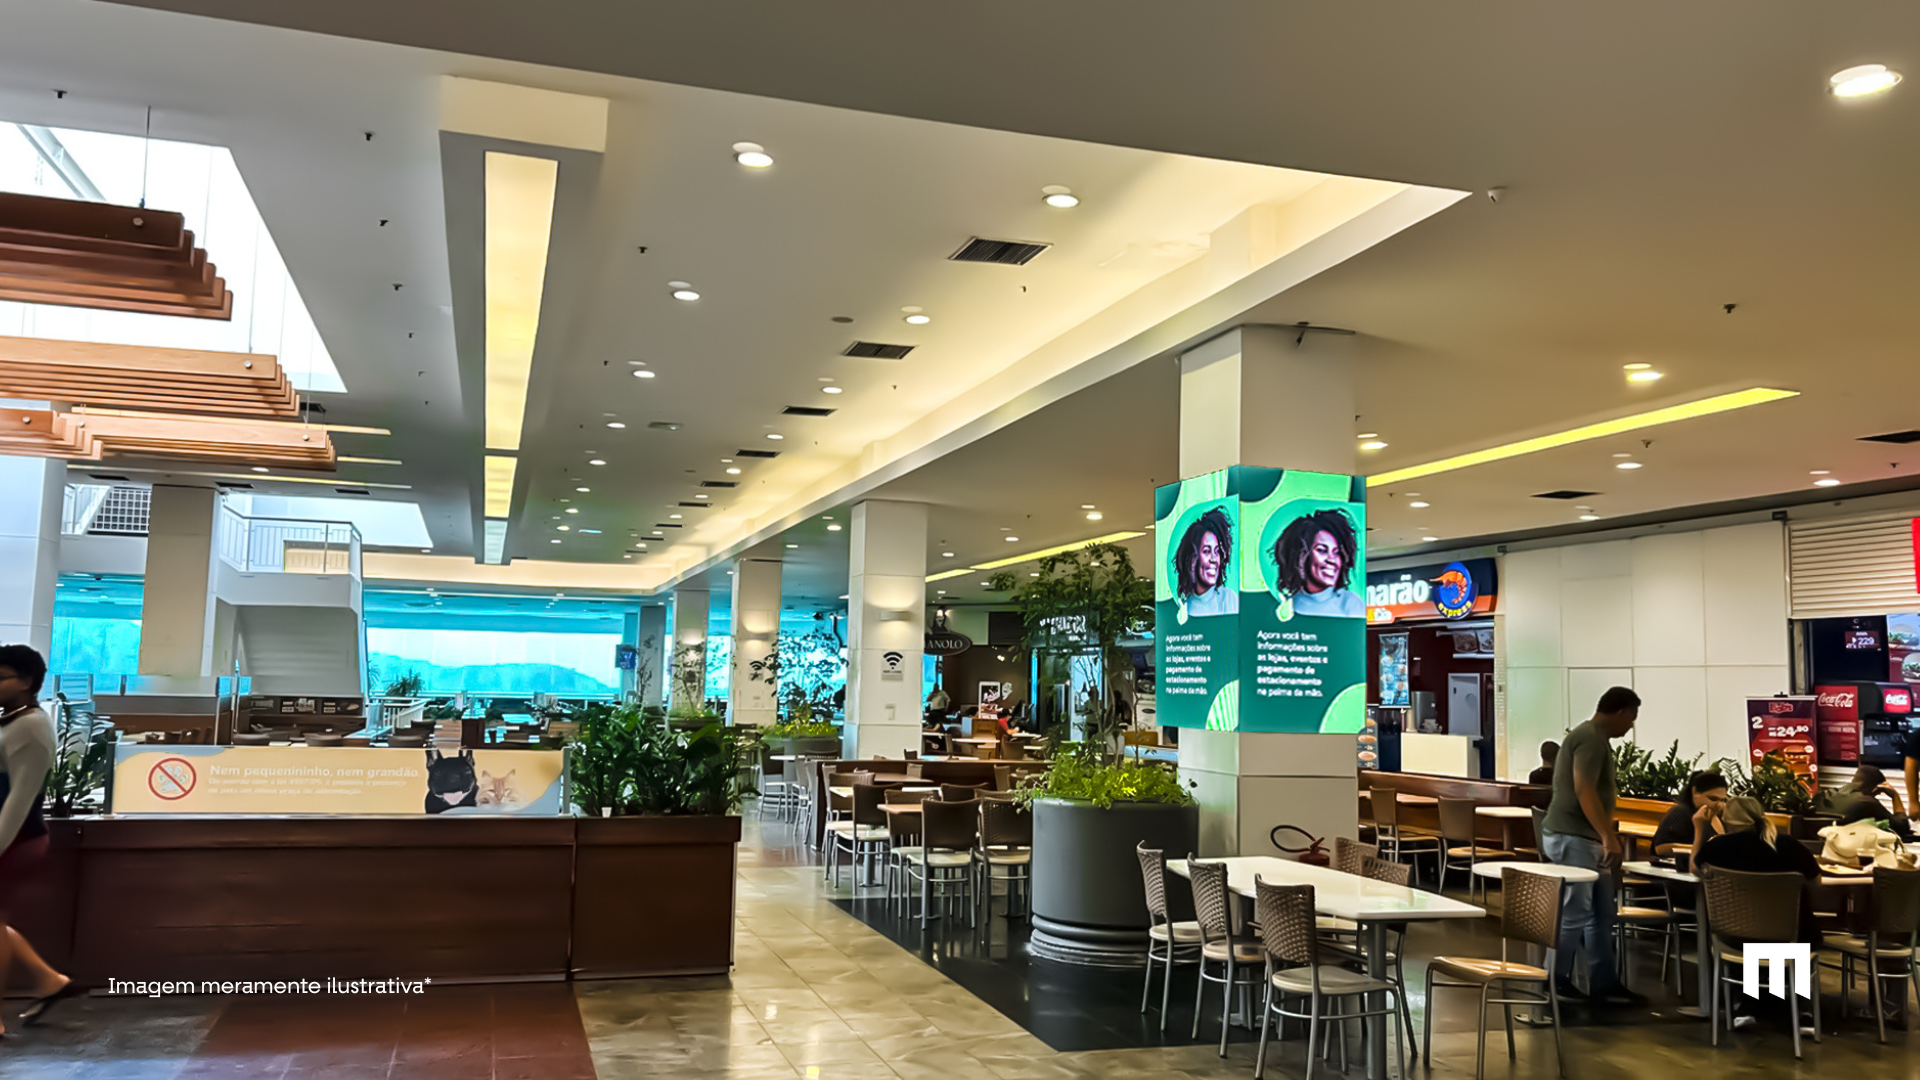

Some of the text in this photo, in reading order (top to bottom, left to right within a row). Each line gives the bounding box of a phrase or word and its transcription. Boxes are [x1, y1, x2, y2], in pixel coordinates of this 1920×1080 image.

[1165, 634, 1180, 644] Agora
[1257, 630, 1280, 640] Agora
[1282, 632, 1299, 640] você
[1257, 642, 1328, 652] informações sobre
[1166, 666, 1194, 674] pagamento
[1257, 666, 1315, 675] pagamento de
[1166, 675, 1207, 684] estacionamento
[1257, 676, 1322, 686] estacionamento
[1172, 687, 1187, 695] palma
[1268, 688, 1292, 697] palma
[1751, 716, 1764, 729] 2
[209, 765, 240, 776] Nem
[243, 766, 333, 778] pequenininho,
[337, 767, 364, 777] nem
